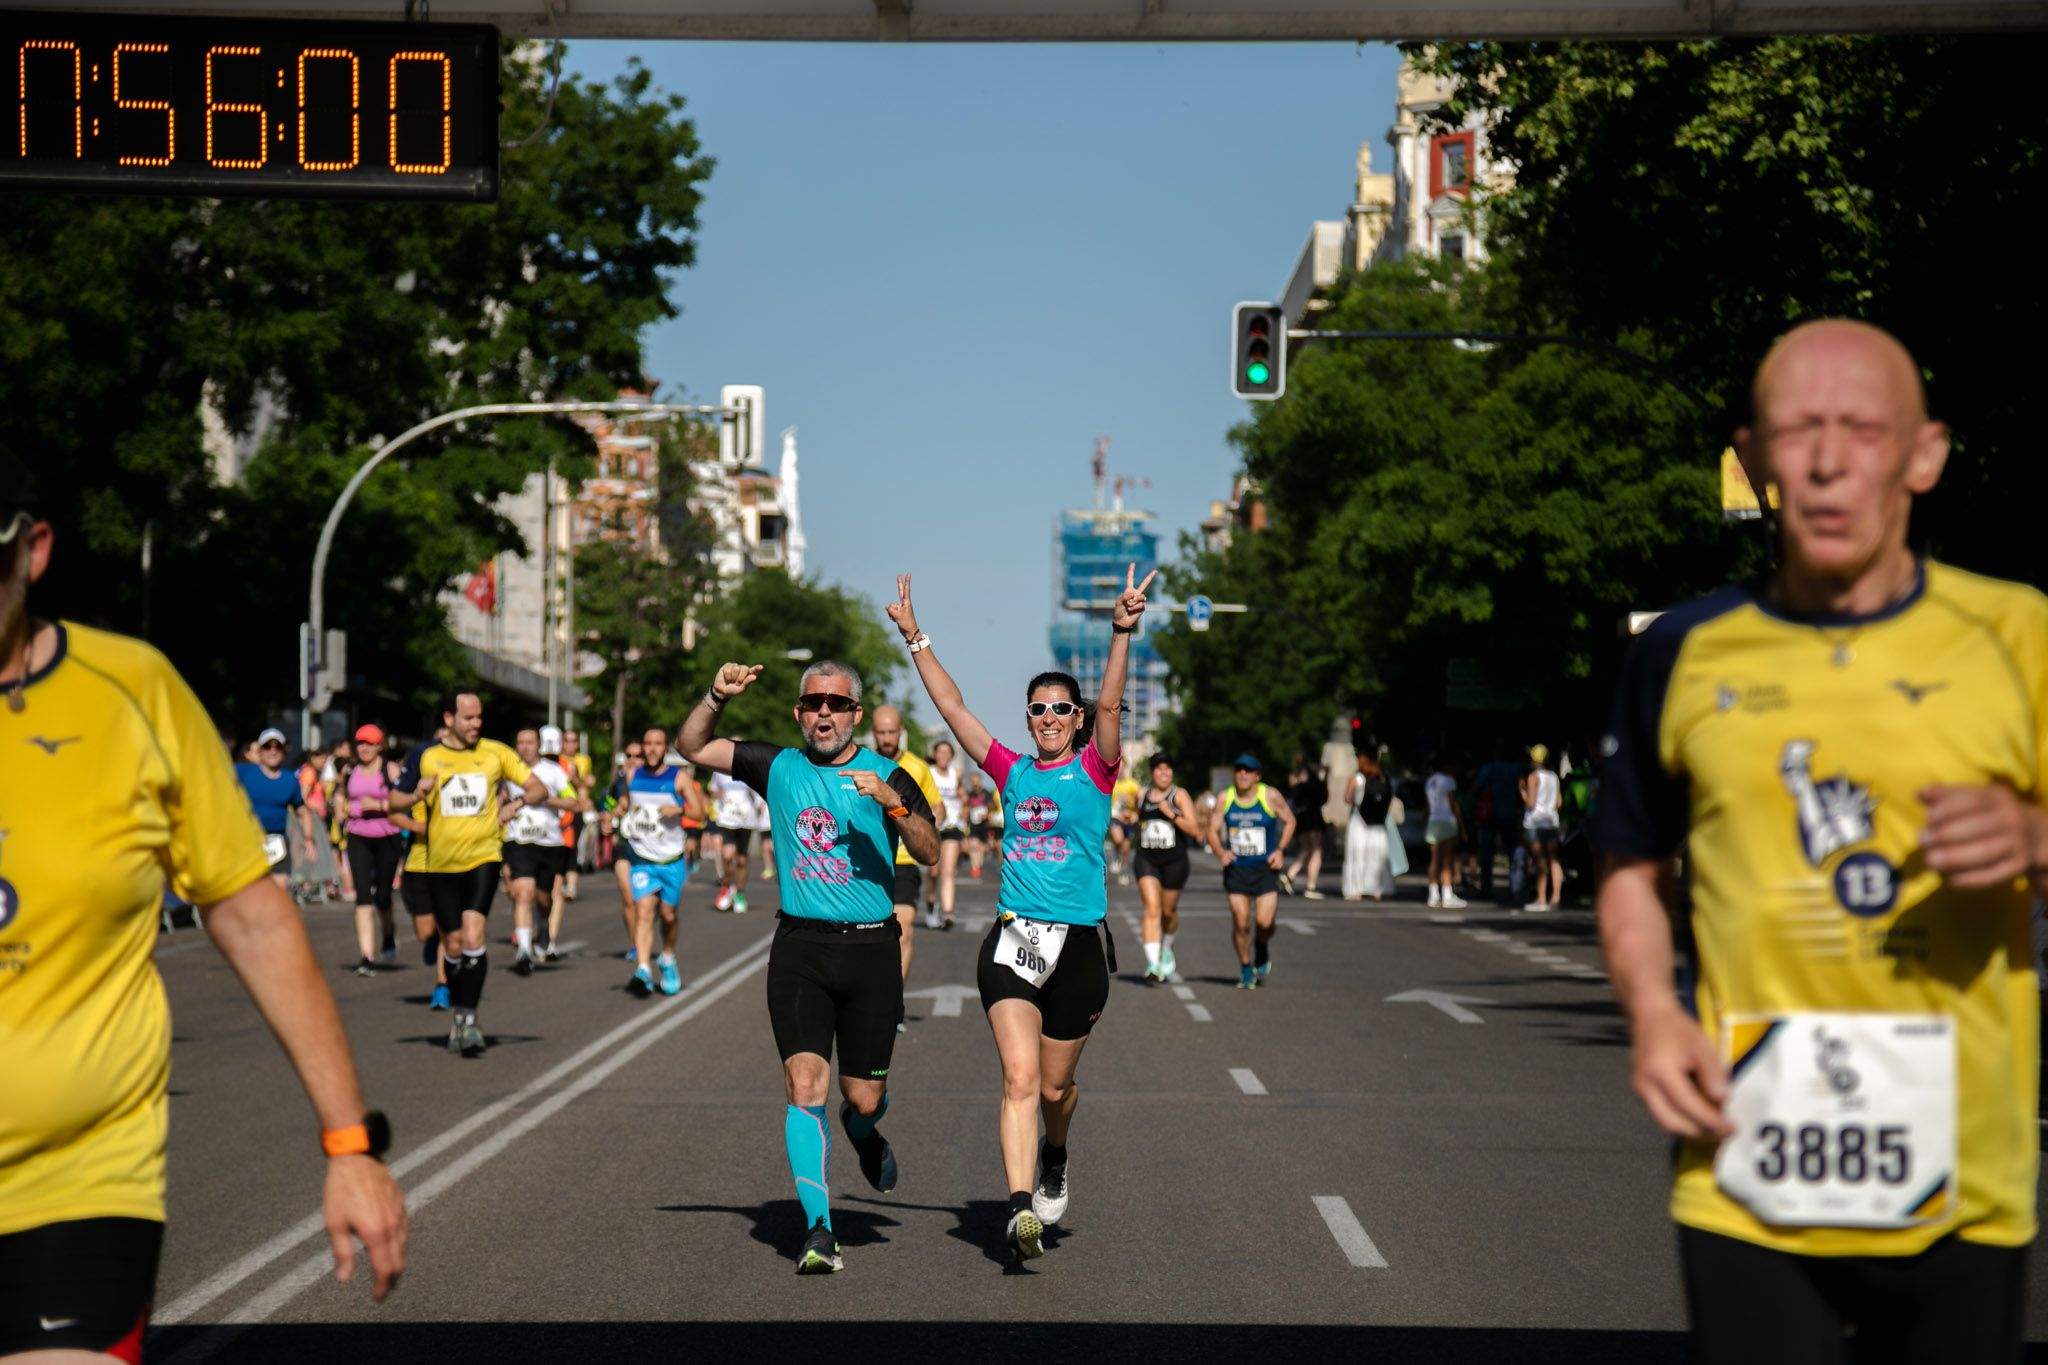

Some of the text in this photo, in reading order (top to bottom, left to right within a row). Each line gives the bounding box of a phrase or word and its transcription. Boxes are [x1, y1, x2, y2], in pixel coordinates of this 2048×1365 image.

[1843, 862, 1892, 906] 13
[1015, 947, 1046, 974] 980
[1757, 1123, 1910, 1184] 3885
